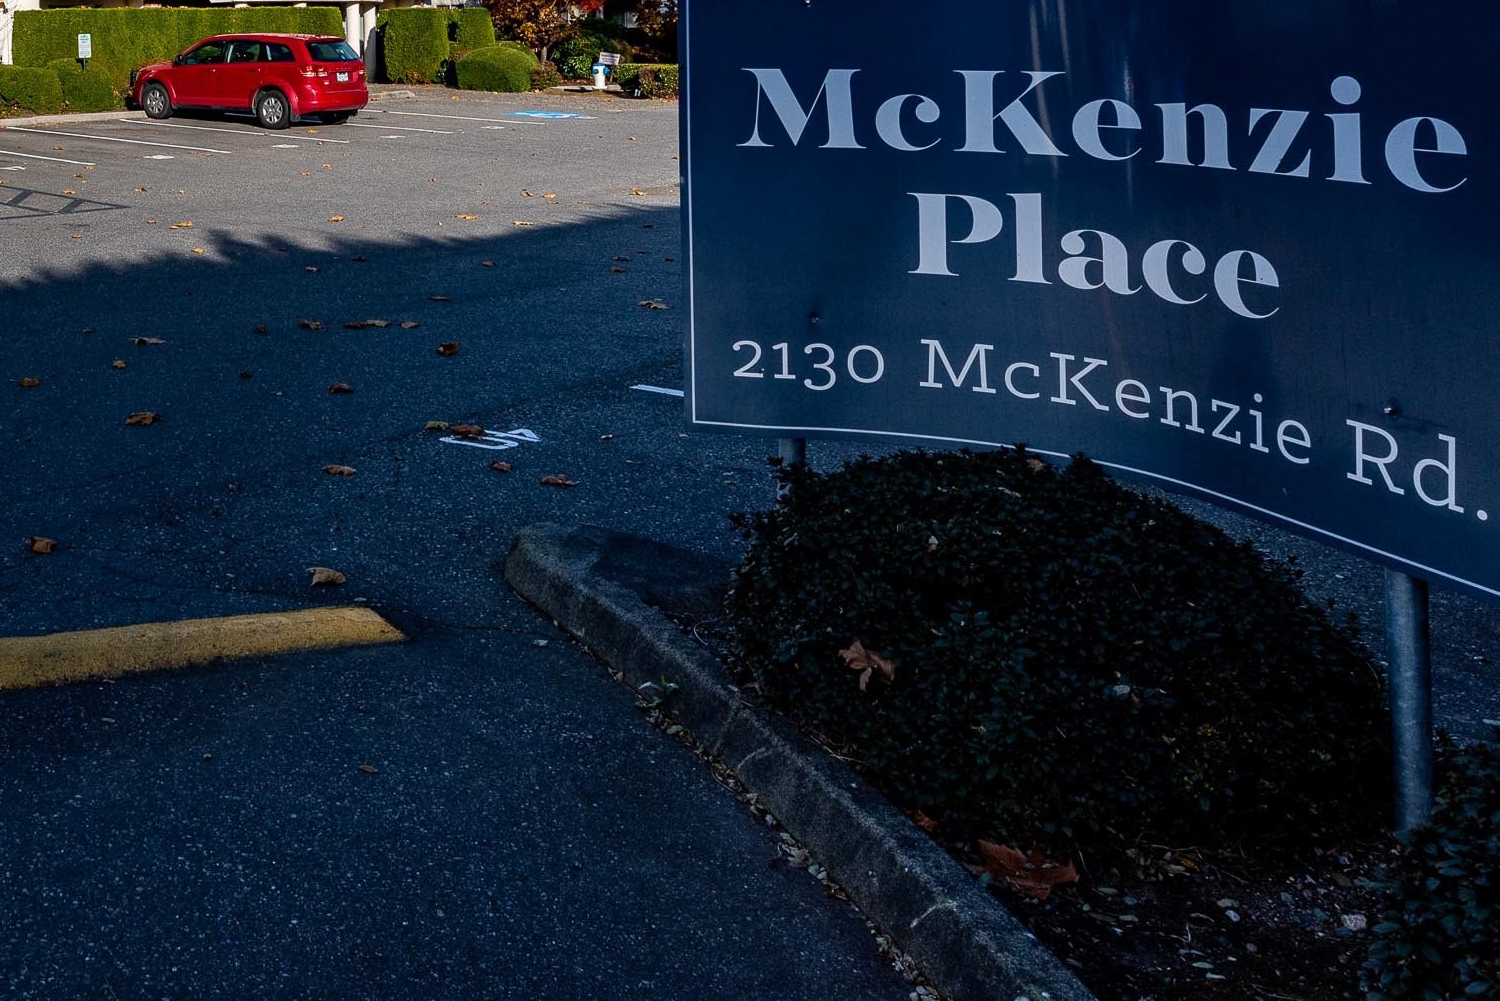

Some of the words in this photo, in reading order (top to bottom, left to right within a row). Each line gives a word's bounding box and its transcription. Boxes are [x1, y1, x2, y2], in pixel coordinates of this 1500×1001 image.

[736, 67, 1468, 193] McKenzie
[906, 191, 1280, 319] Place
[732, 339, 886, 391] 2130
[919, 338, 1312, 465] McKenzie
[1345, 418, 1489, 521] Rd.
